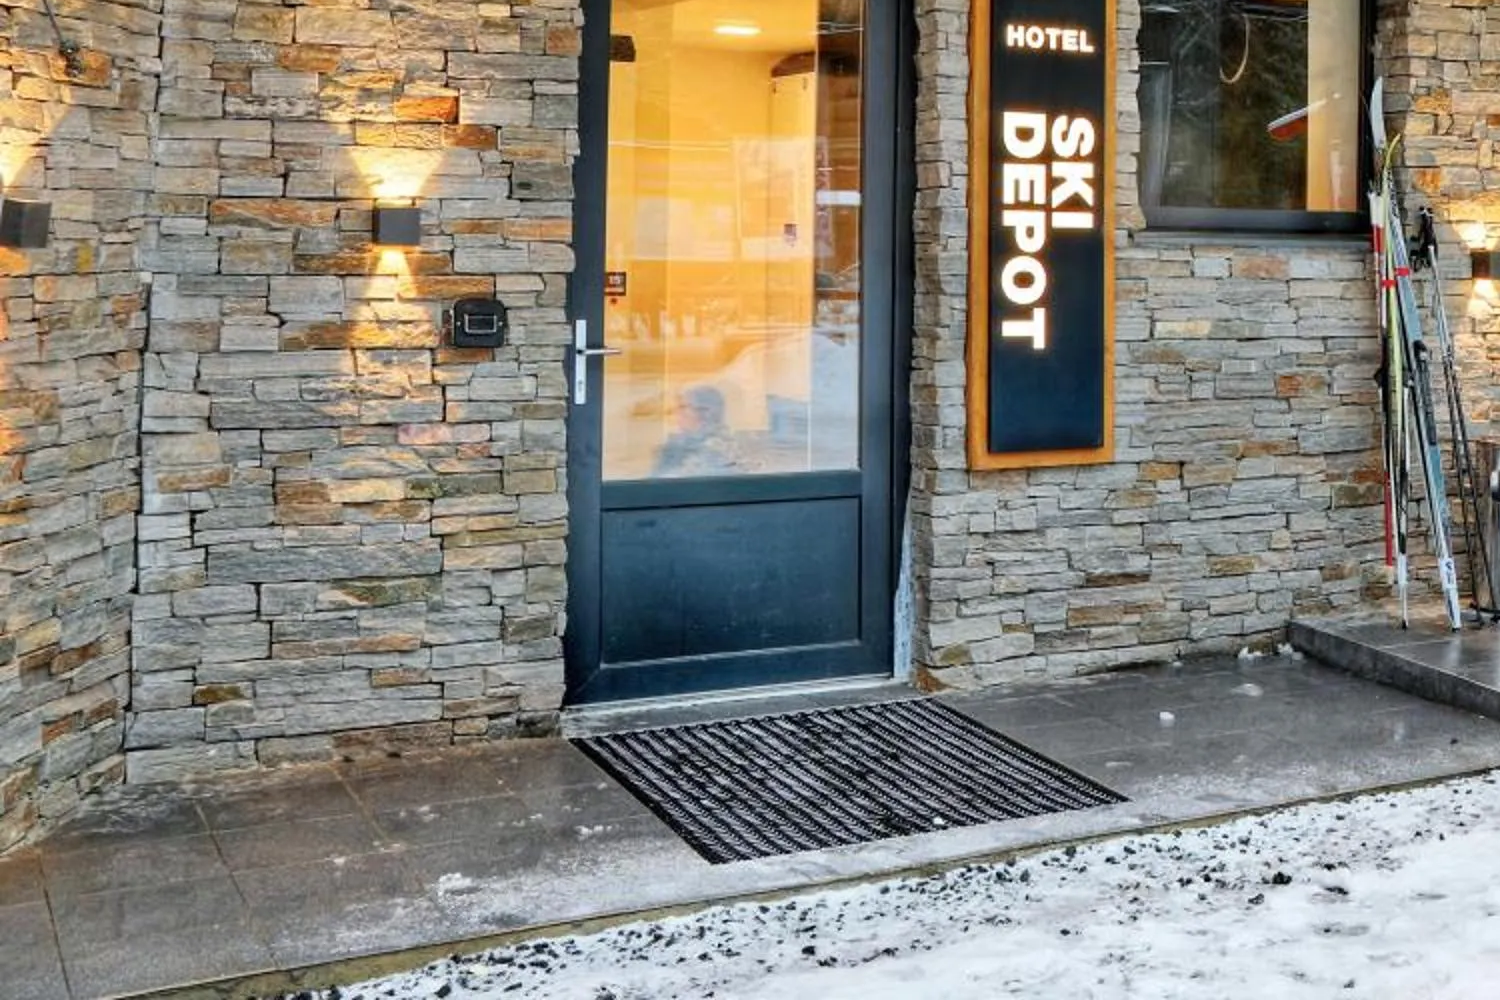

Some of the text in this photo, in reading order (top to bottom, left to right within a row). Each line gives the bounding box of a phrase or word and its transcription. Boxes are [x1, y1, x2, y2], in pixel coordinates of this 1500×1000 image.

[1006, 24, 1094, 53] HOTEL
[1052, 115, 1095, 230] SKI
[1001, 112, 1048, 350] DEPOT
